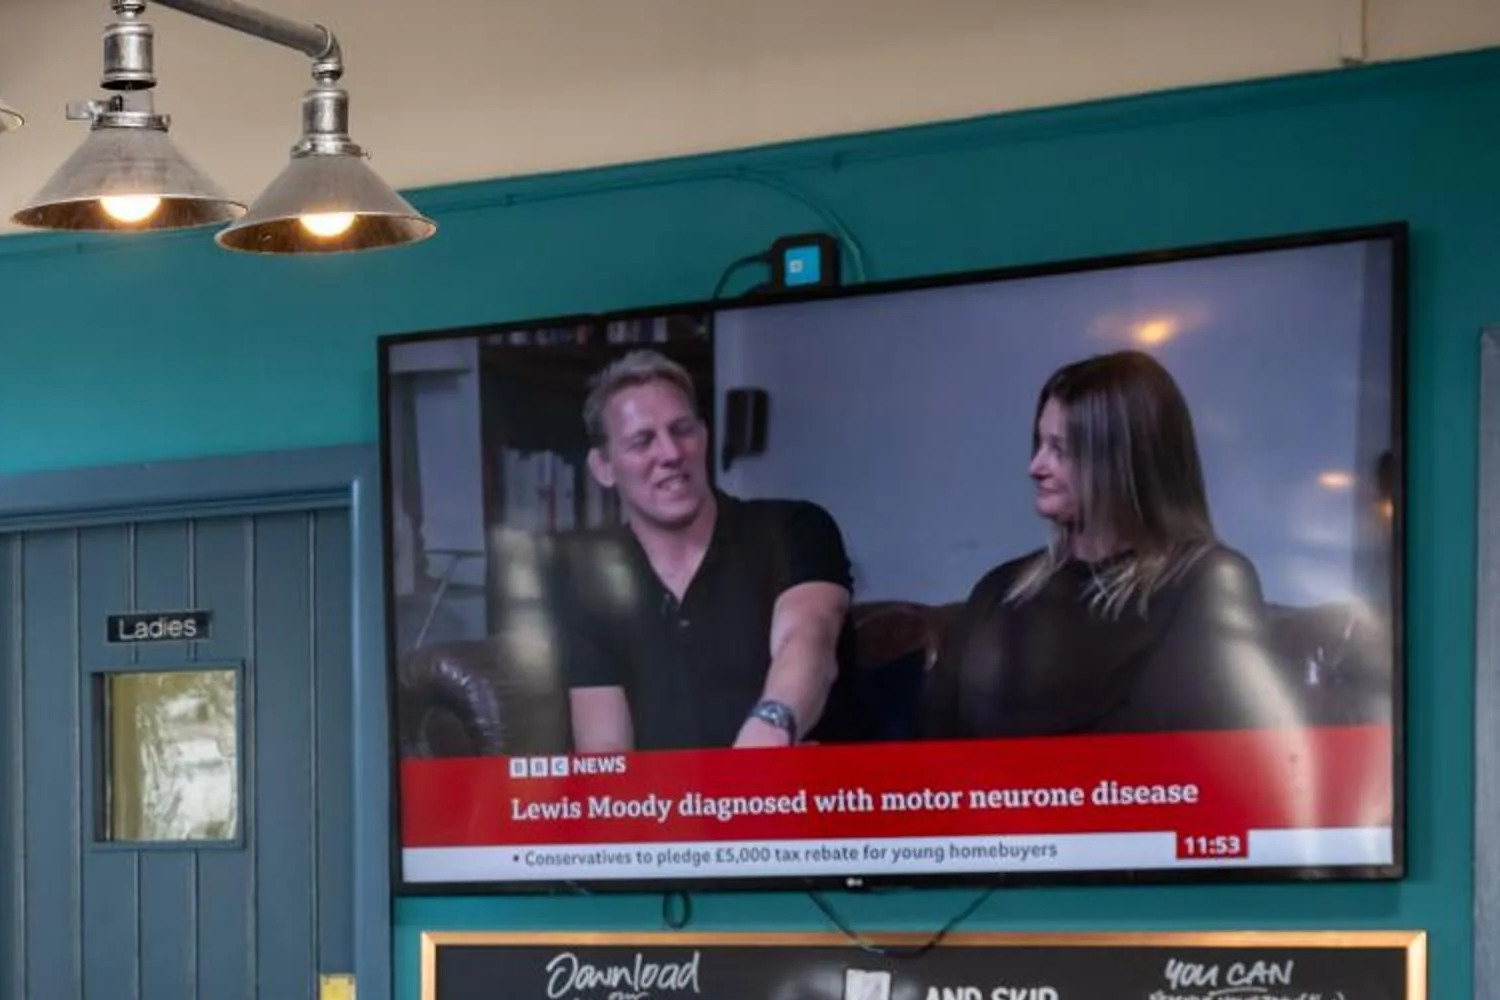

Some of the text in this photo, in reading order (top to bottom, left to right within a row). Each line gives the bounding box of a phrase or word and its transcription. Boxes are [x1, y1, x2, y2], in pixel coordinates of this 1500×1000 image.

[118, 617, 197, 641] Ladies
[510, 755, 626, 778] BBC NEWS
[511, 780, 1199, 823] Lewis Moody diagnosed with motor neurone disease
[525, 841, 1058, 867] Conservatives to pledge £5,000 tax rebate for young homebuyers
[1184, 835, 1241, 856] 11:53
[546, 950, 701, 999] Download
[1226, 960, 1294, 986] CAN
